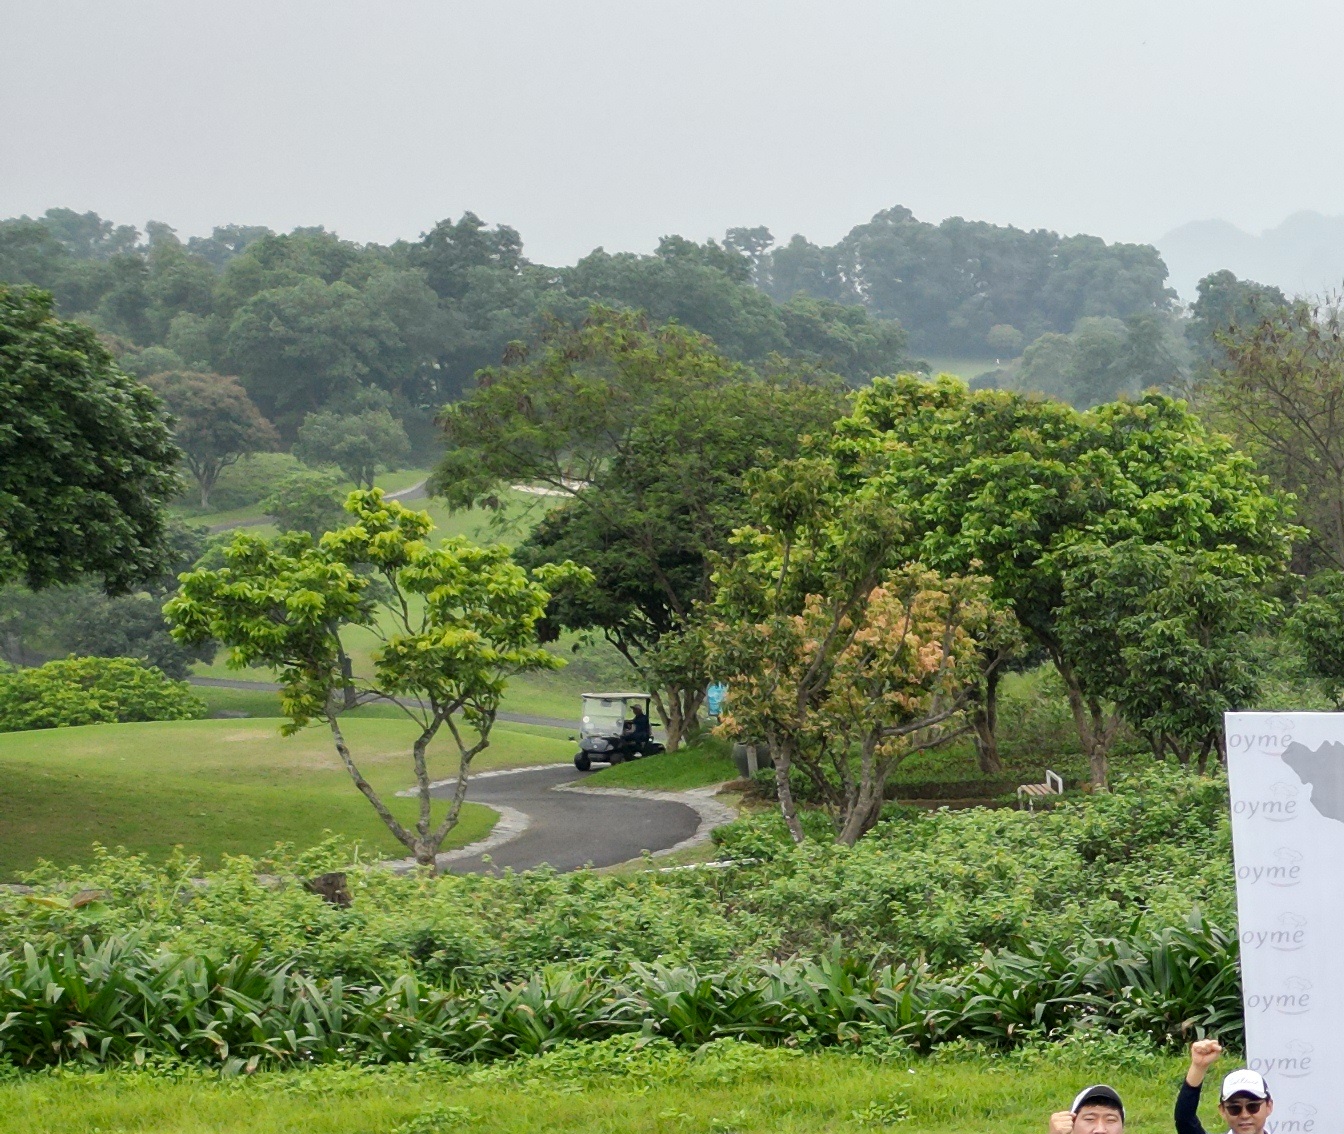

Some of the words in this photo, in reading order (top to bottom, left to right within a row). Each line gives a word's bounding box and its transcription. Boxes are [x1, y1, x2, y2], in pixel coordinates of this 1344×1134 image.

[1229, 732, 1293, 753] oyme
[1233, 797, 1297, 816] oyme
[1237, 861, 1301, 881] oyme
[1241, 927, 1305, 949] oyme
[1247, 990, 1310, 1013] oyme
[1249, 1054, 1312, 1075] oyme
